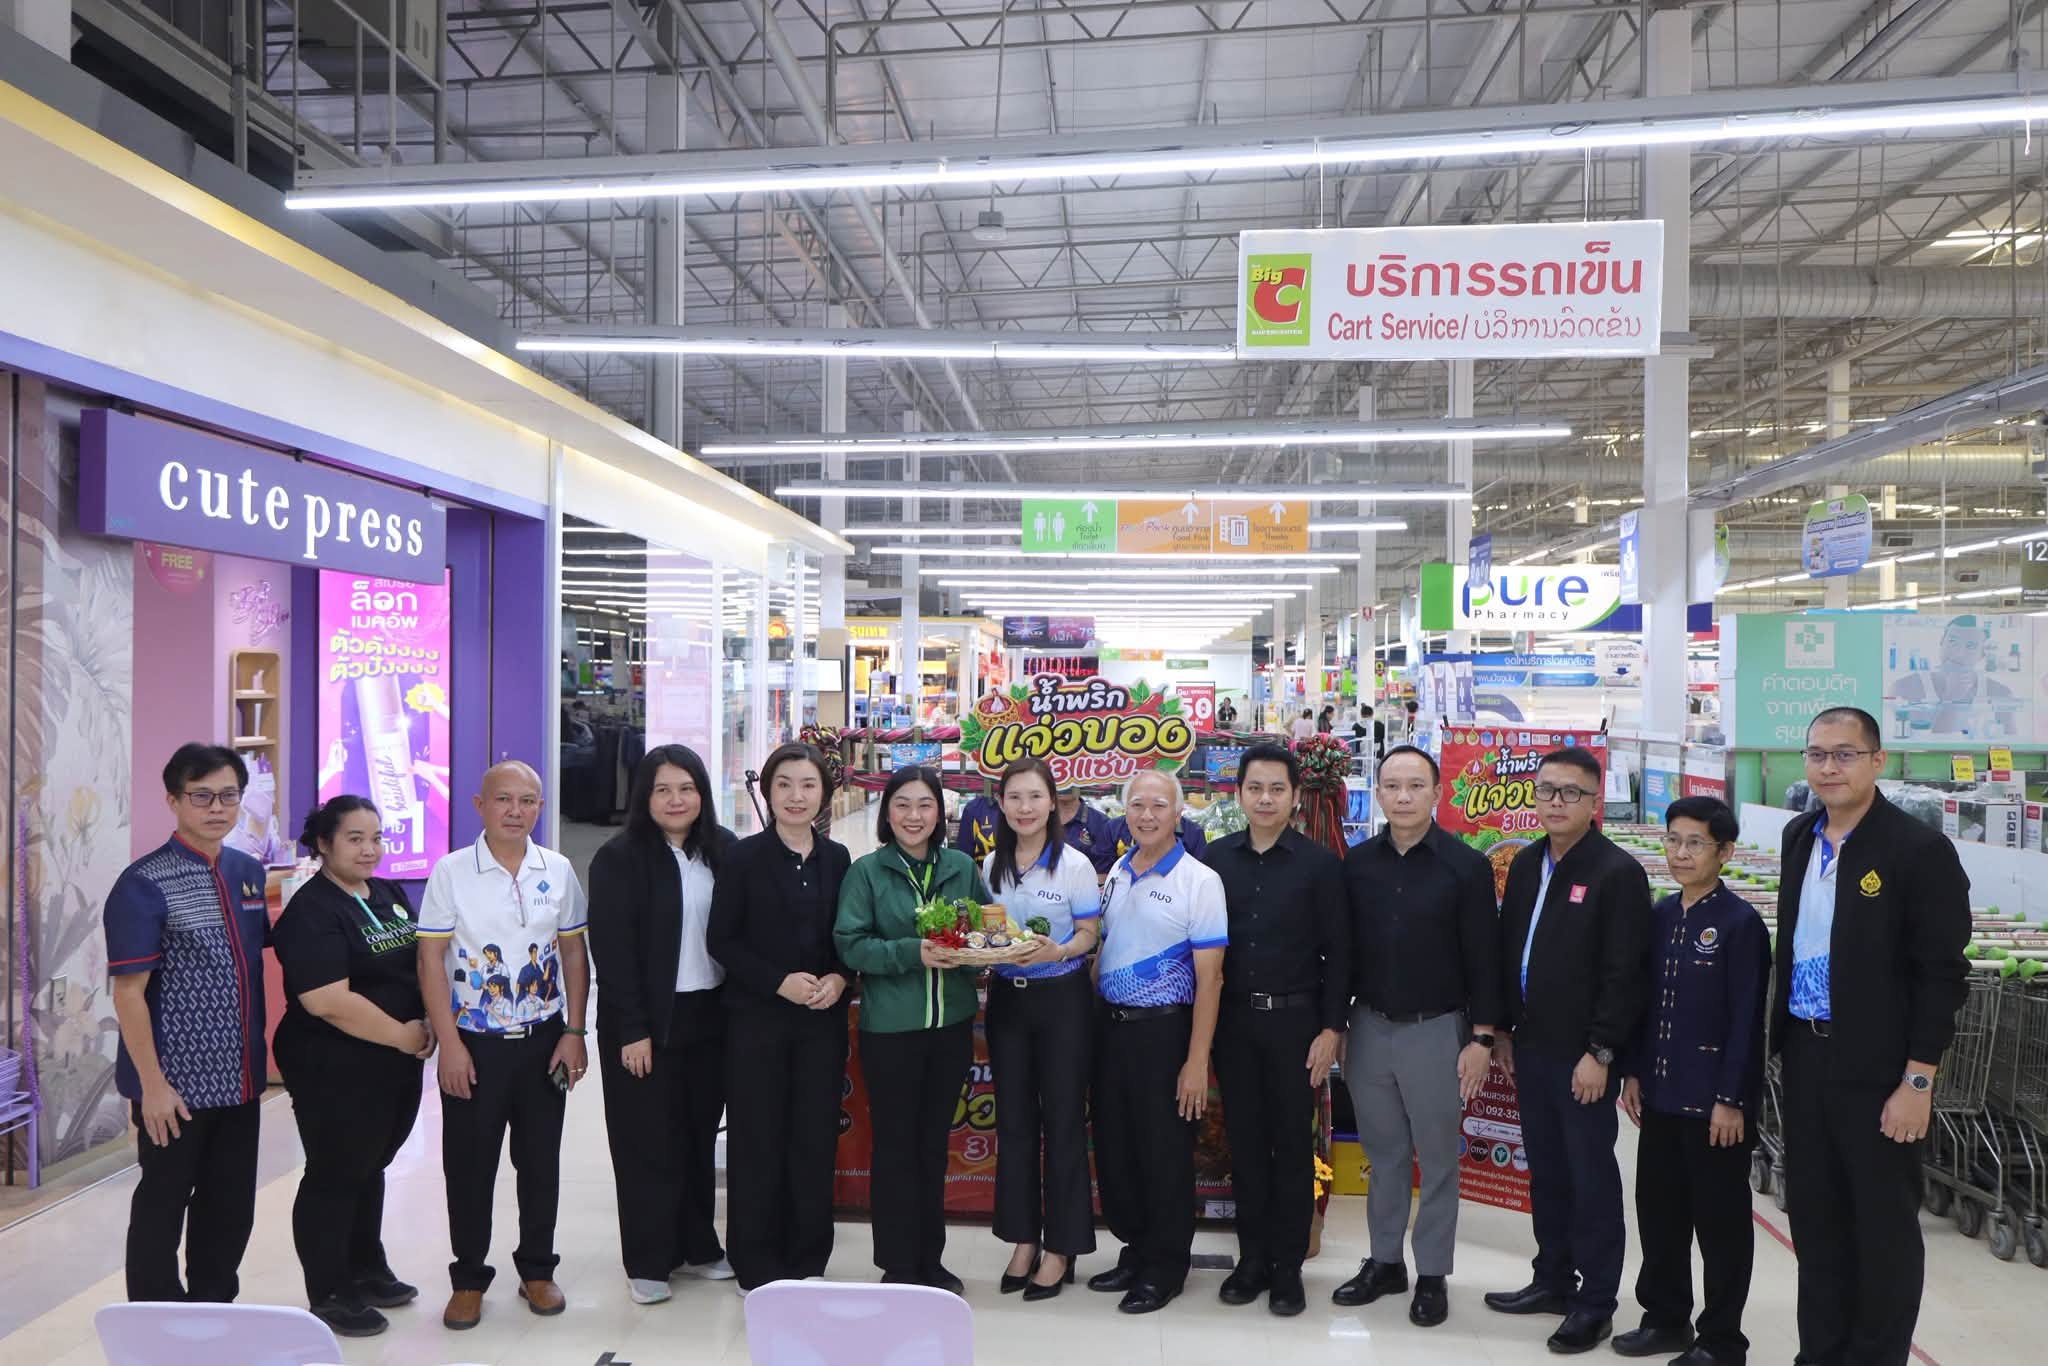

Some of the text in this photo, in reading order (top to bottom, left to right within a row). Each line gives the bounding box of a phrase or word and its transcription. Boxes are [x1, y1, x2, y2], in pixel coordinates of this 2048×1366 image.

[1251, 265, 1284, 285] Big
[1346, 240, 1643, 297] บริการรถเข็น
[1254, 267, 1307, 324] C
[1327, 312, 1372, 341] Cart
[159, 461, 424, 560] cute press
[161, 552, 193, 570] FREE
[350, 580, 418, 612] ล็อก
[1462, 576, 1589, 618] pure
[351, 612, 418, 629] เมคอัพ
[1474, 609, 1569, 622] Pharmacy
[1031, 678, 1124, 713] น้ำพริก
[1762, 672, 1857, 697] คำตอบดีๆ
[985, 713, 1190, 766] แจ่วบอง
[1052, 758, 1071, 782] 3
[1503, 813, 1516, 831] 3
[366, 922, 417, 945] COMMITMEN
[1494, 1074, 1505, 1085] 12
[963, 1135, 989, 1161] 3
